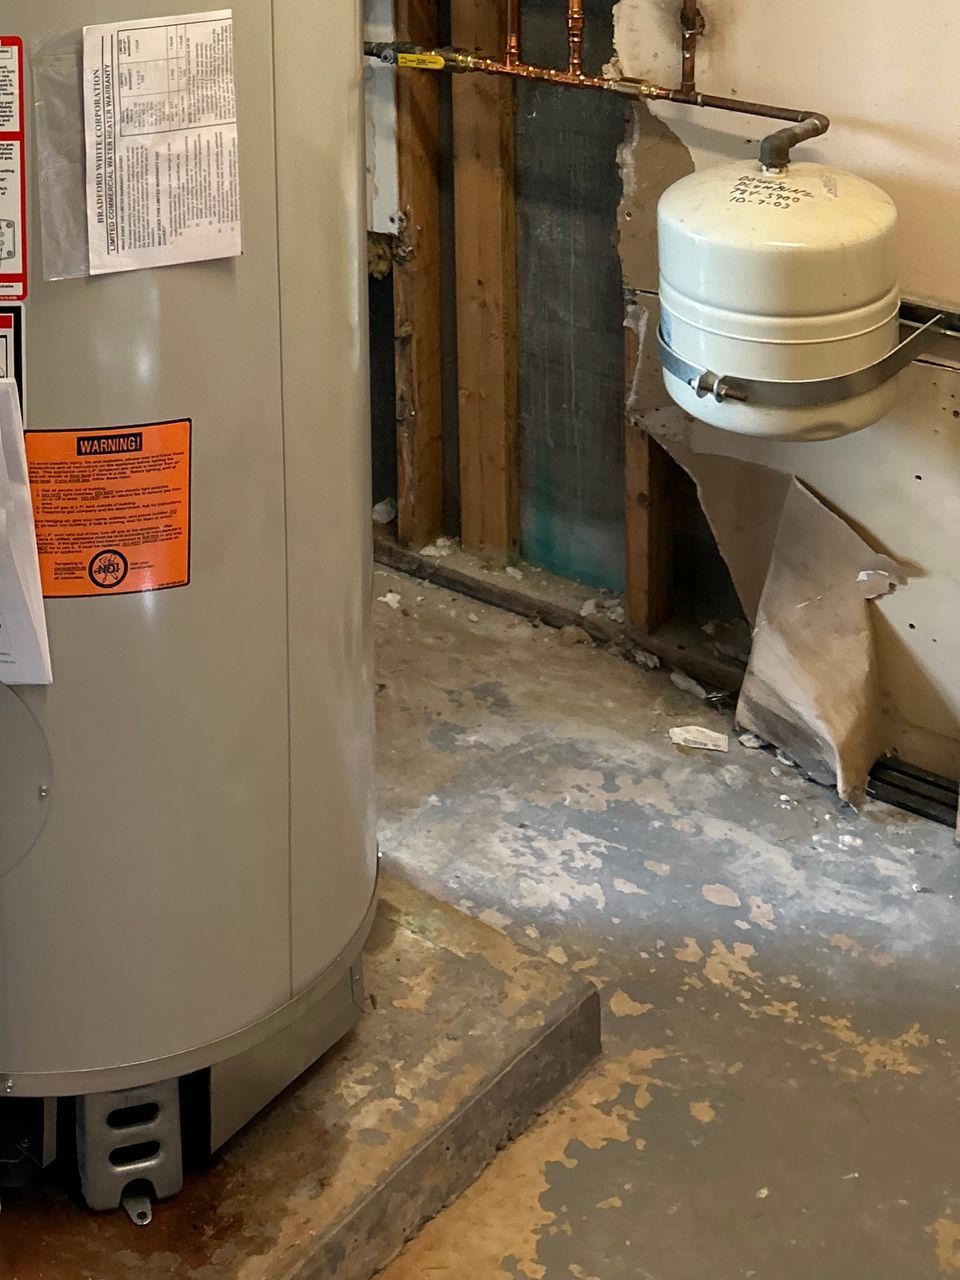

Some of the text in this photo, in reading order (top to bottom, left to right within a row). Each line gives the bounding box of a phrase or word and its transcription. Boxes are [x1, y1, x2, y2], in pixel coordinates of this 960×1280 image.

[93, 70, 105, 223] BRADFORD WHITE CORPORATION
[105, 65, 117, 251] LIMITED COMMERCIAL WATER HEATER WARRANTY
[80, 436, 140, 454] WARNING!
